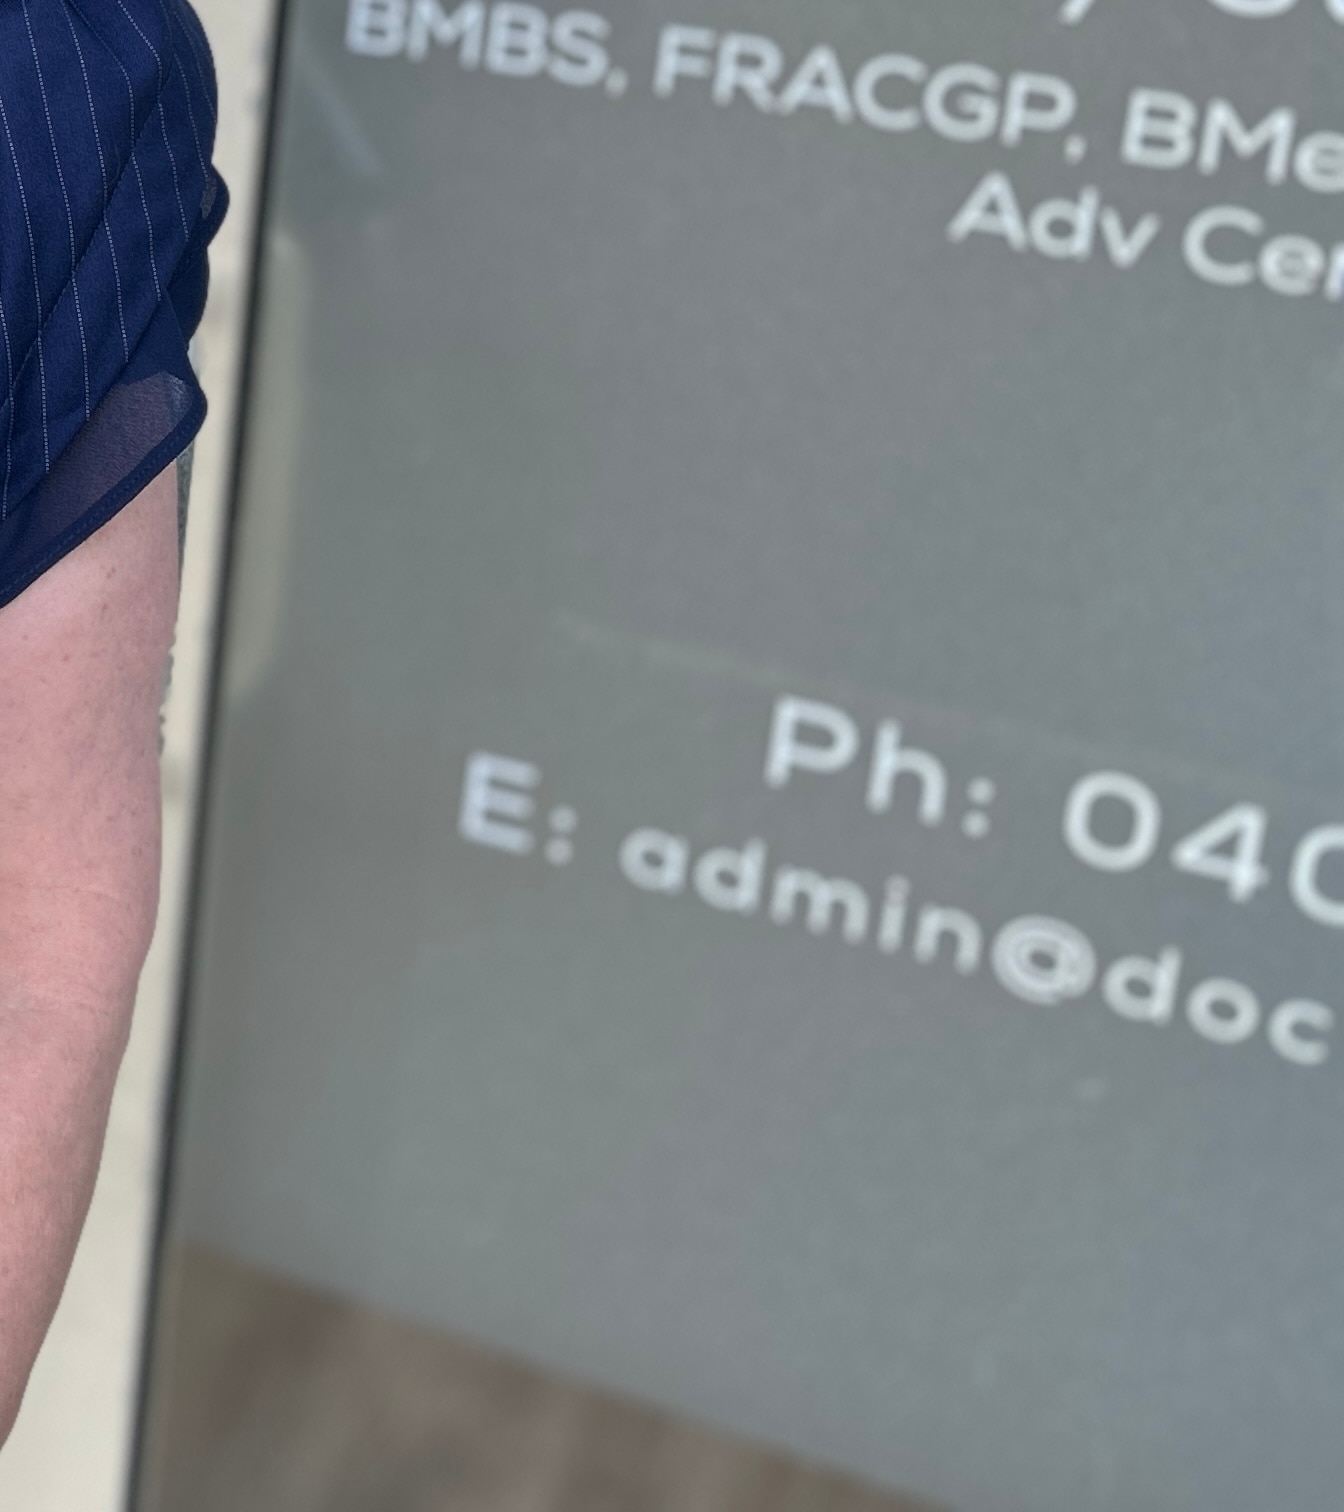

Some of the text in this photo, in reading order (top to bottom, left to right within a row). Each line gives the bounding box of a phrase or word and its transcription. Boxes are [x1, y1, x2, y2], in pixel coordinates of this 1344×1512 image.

[653, 23, 1087, 164] FRACGP,
[947, 168, 1160, 270] Adv
[458, 750, 578, 866] E:
[764, 693, 998, 838] Ph:
